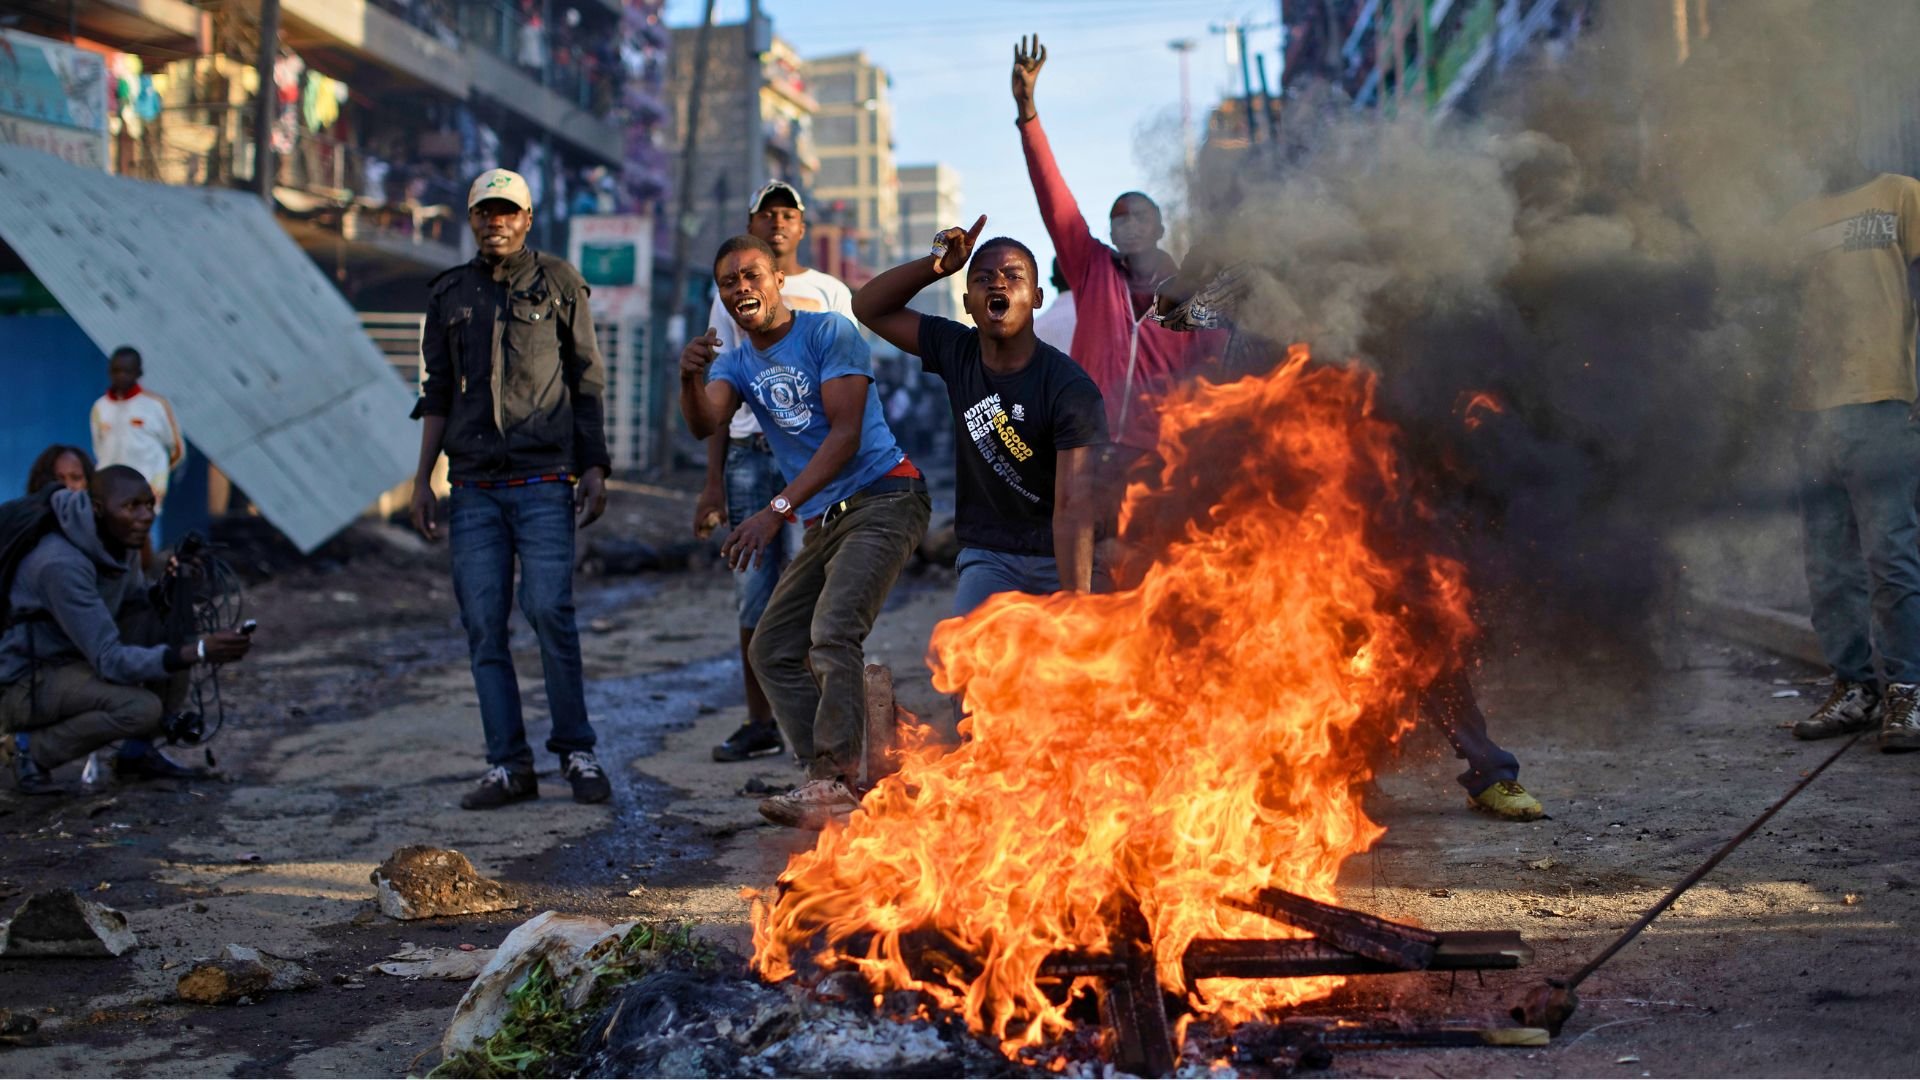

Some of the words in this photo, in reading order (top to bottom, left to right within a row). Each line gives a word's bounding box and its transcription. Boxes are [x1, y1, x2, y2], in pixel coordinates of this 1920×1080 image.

[964, 393, 1000, 421] NOTHING
[966, 413, 985, 432] BUT
[984, 403, 1003, 420] THE
[970, 419, 996, 442] BEST
[992, 416, 1028, 462] ENOUGH
[996, 410, 1009, 425] IS
[1006, 425, 1034, 457] GOOD
[975, 440, 997, 464] NISI
[983, 433, 999, 454] NIL
[997, 454, 1023, 484] SATIS
